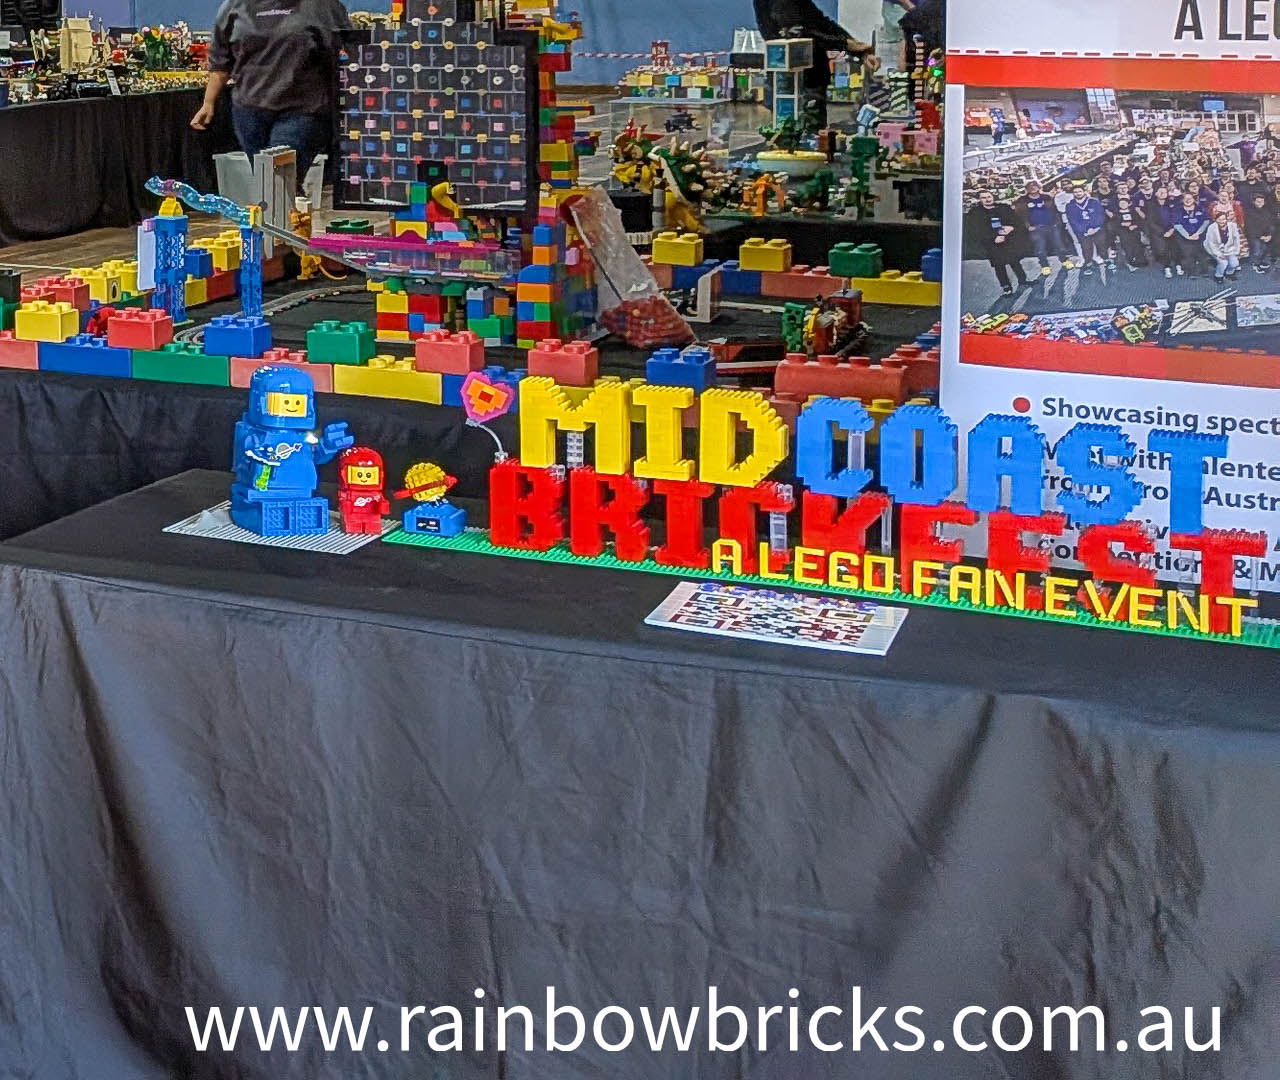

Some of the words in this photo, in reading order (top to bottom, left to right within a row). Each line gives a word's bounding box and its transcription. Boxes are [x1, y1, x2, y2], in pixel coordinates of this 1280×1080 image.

[520, 375, 790, 487] MID
[796, 397, 1228, 536] COAST
[1042, 397, 1199, 433] Showcasing
[1121, 448, 1171, 471] with
[490, 457, 1268, 636] BRICKFEST
[712, 539, 743, 575] A
[756, 545, 895, 596] LEGO
[912, 559, 1026, 612] FAN
[1044, 576, 1260, 637] EVENT
